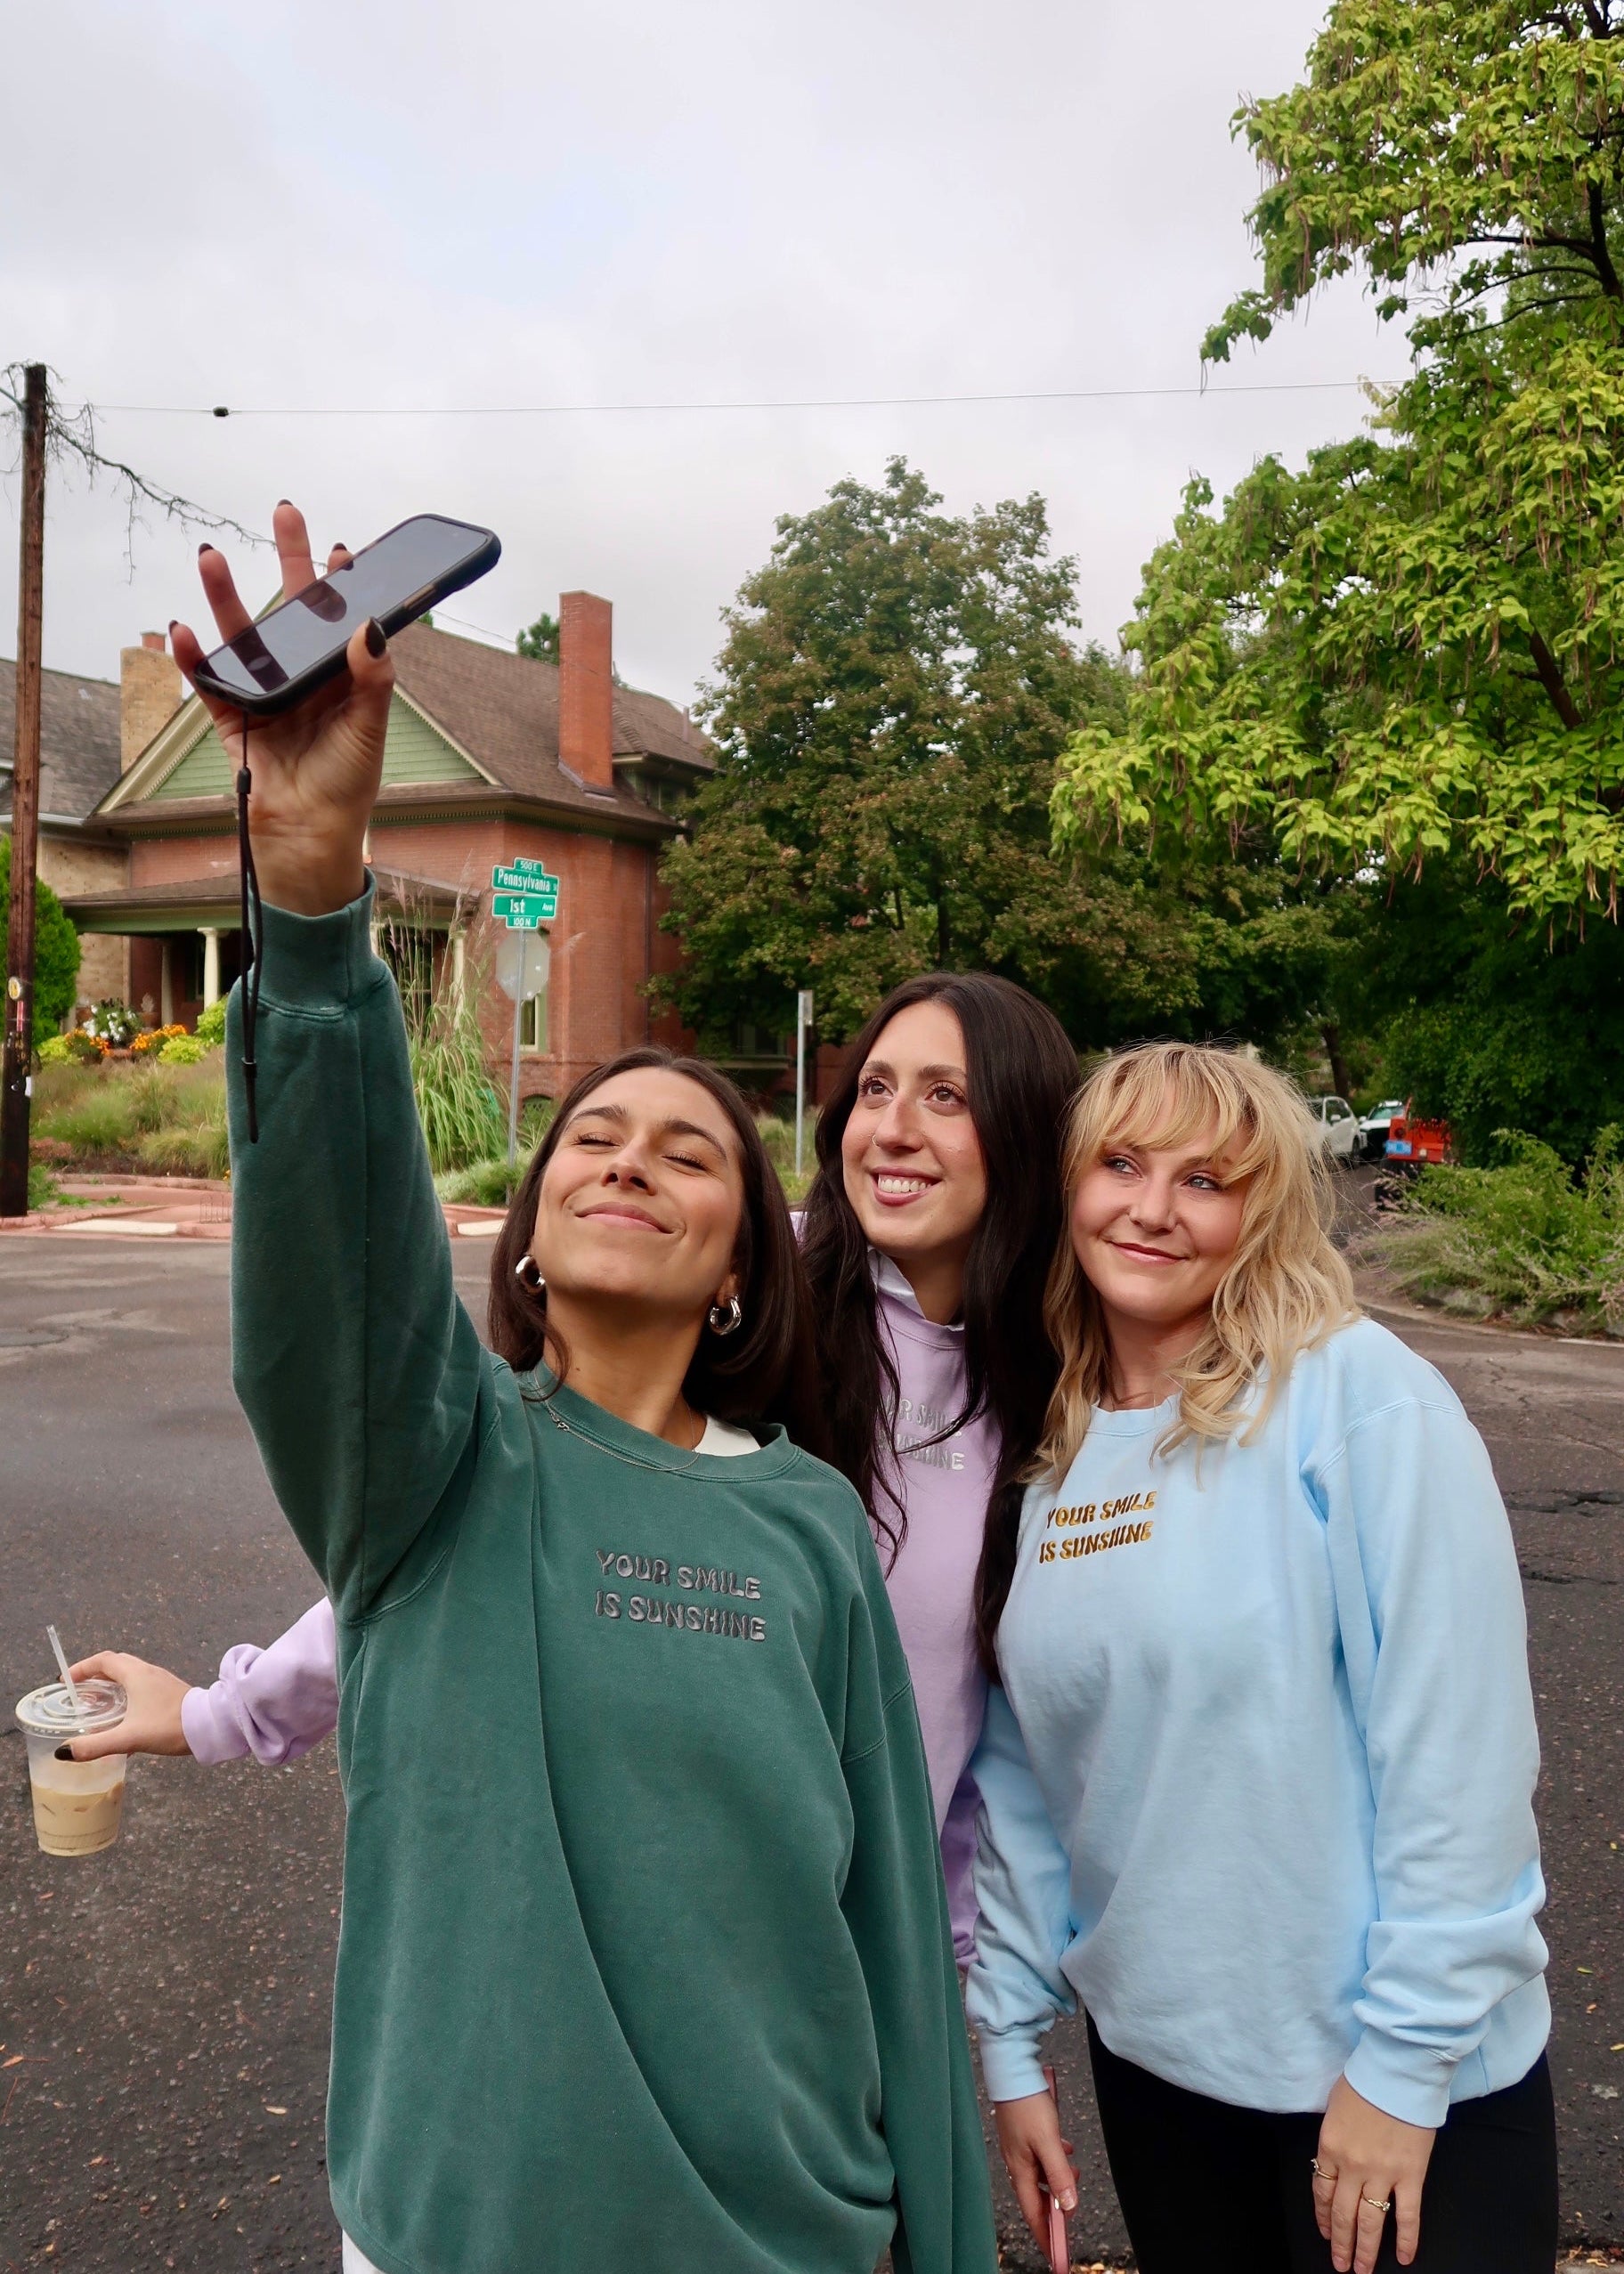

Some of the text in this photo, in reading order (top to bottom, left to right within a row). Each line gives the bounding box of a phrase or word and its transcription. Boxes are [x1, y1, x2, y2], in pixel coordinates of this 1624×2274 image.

[498, 868, 550, 892] Pennsylvania
[520, 861, 538, 872] 500 E
[510, 898, 525, 914] 1st
[514, 918, 531, 926] 100 N
[1047, 1490, 1157, 1529] YOUR SMILE
[1039, 1521, 1155, 1563] IS SUNSHINE
[596, 1549, 761, 1600] YOUR SMILE
[595, 1589, 767, 1642] IS SUNSHINE
